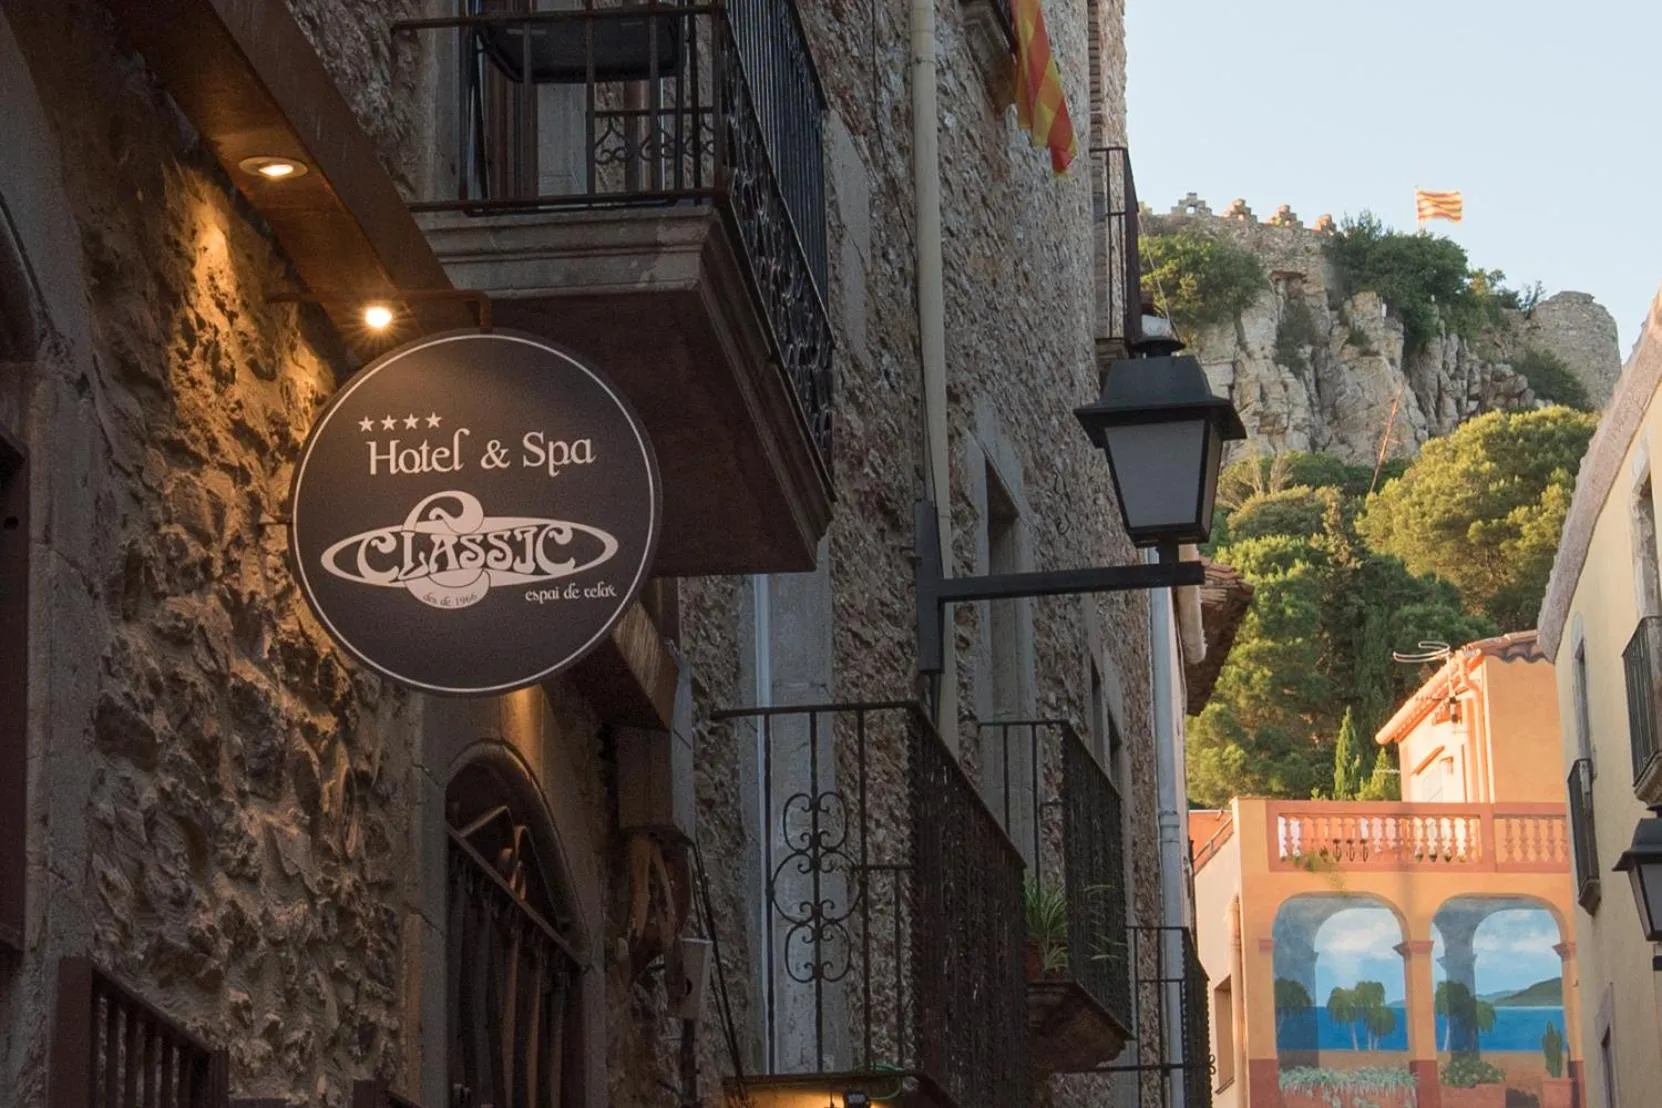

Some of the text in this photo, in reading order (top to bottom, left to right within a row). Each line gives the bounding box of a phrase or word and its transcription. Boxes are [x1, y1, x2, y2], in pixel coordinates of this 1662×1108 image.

[366, 428, 597, 477] Hotel & Spa
[357, 523, 577, 581] CLASSIC
[525, 580, 617, 604] espai de relax
